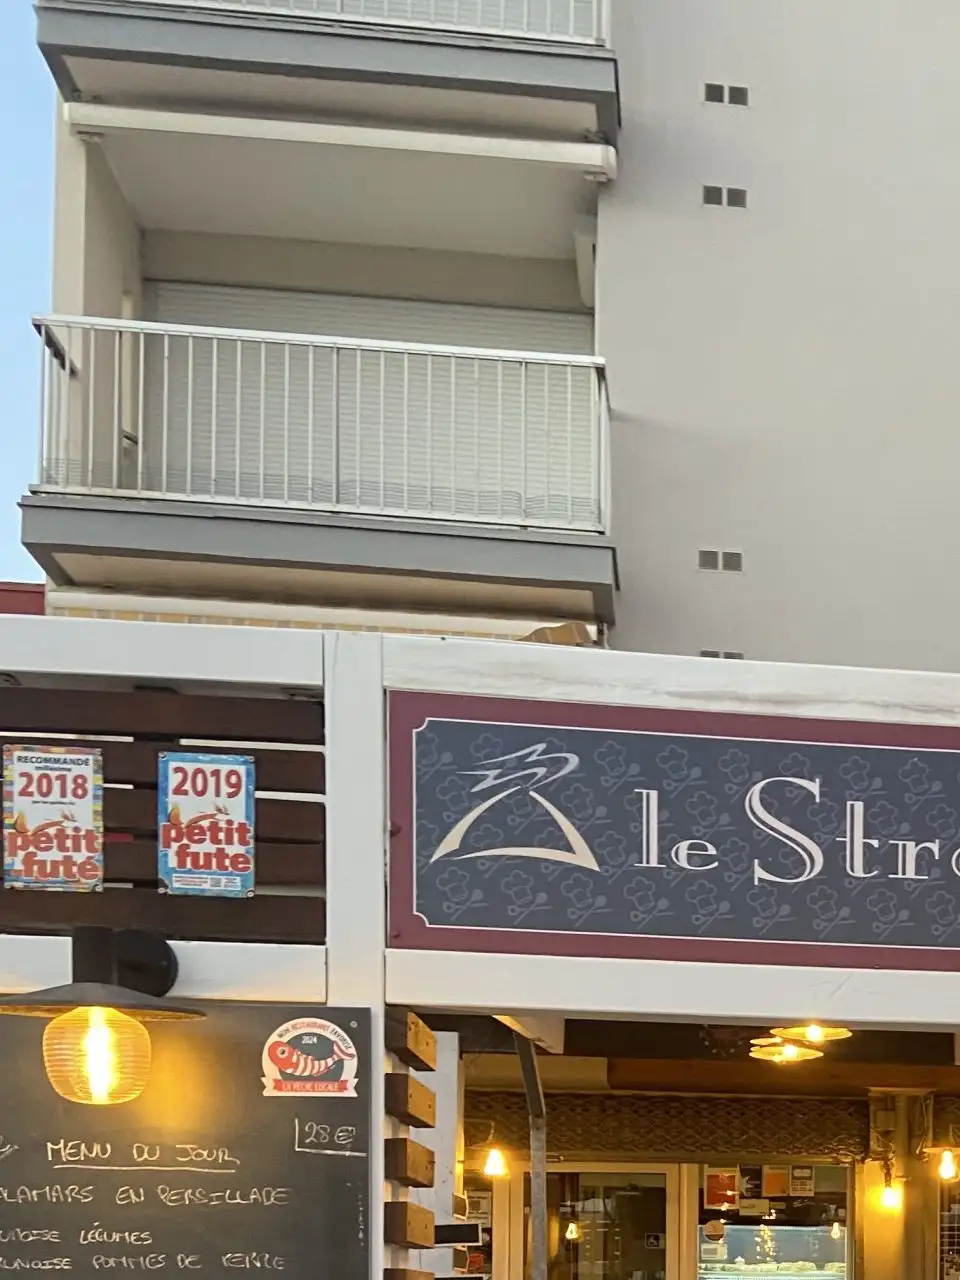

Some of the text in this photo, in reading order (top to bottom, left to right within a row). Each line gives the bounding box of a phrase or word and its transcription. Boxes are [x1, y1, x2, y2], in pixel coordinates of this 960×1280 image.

[17, 755, 90, 766] RECOMMANDÉ
[18, 772, 88, 799] 2018
[172, 766, 242, 798] 2019
[8, 826, 99, 857] petit
[162, 819, 251, 848] petit
[634, 789, 719, 870] le
[46, 1139, 240, 1164] MENU DU JOUR
[116, 1187, 144, 1204] EN
[93, 1254, 166, 1270] POMMES
[177, 1254, 202, 1269] DE
